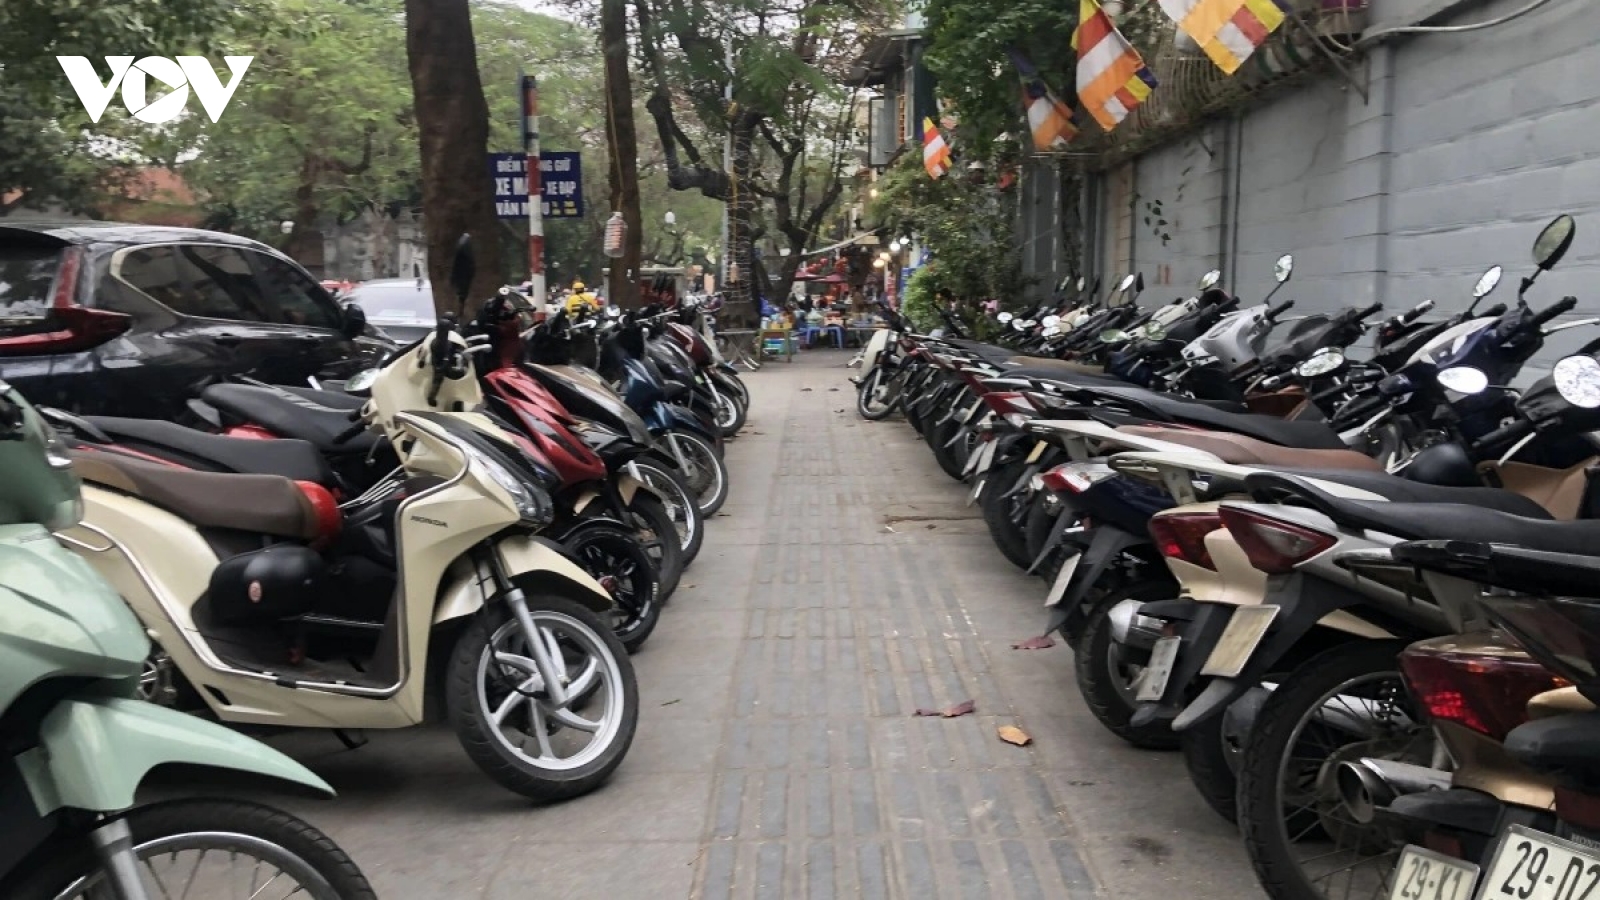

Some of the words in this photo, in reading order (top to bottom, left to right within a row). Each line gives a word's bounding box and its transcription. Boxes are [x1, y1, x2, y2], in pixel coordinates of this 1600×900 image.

[523, 160, 552, 172] TNG
[495, 177, 511, 195] XE
[546, 181, 557, 195] XE
[521, 203, 549, 215] MU
[1571, 832, 1600, 849] HOND
[1401, 857, 1463, 900] 29-K1
